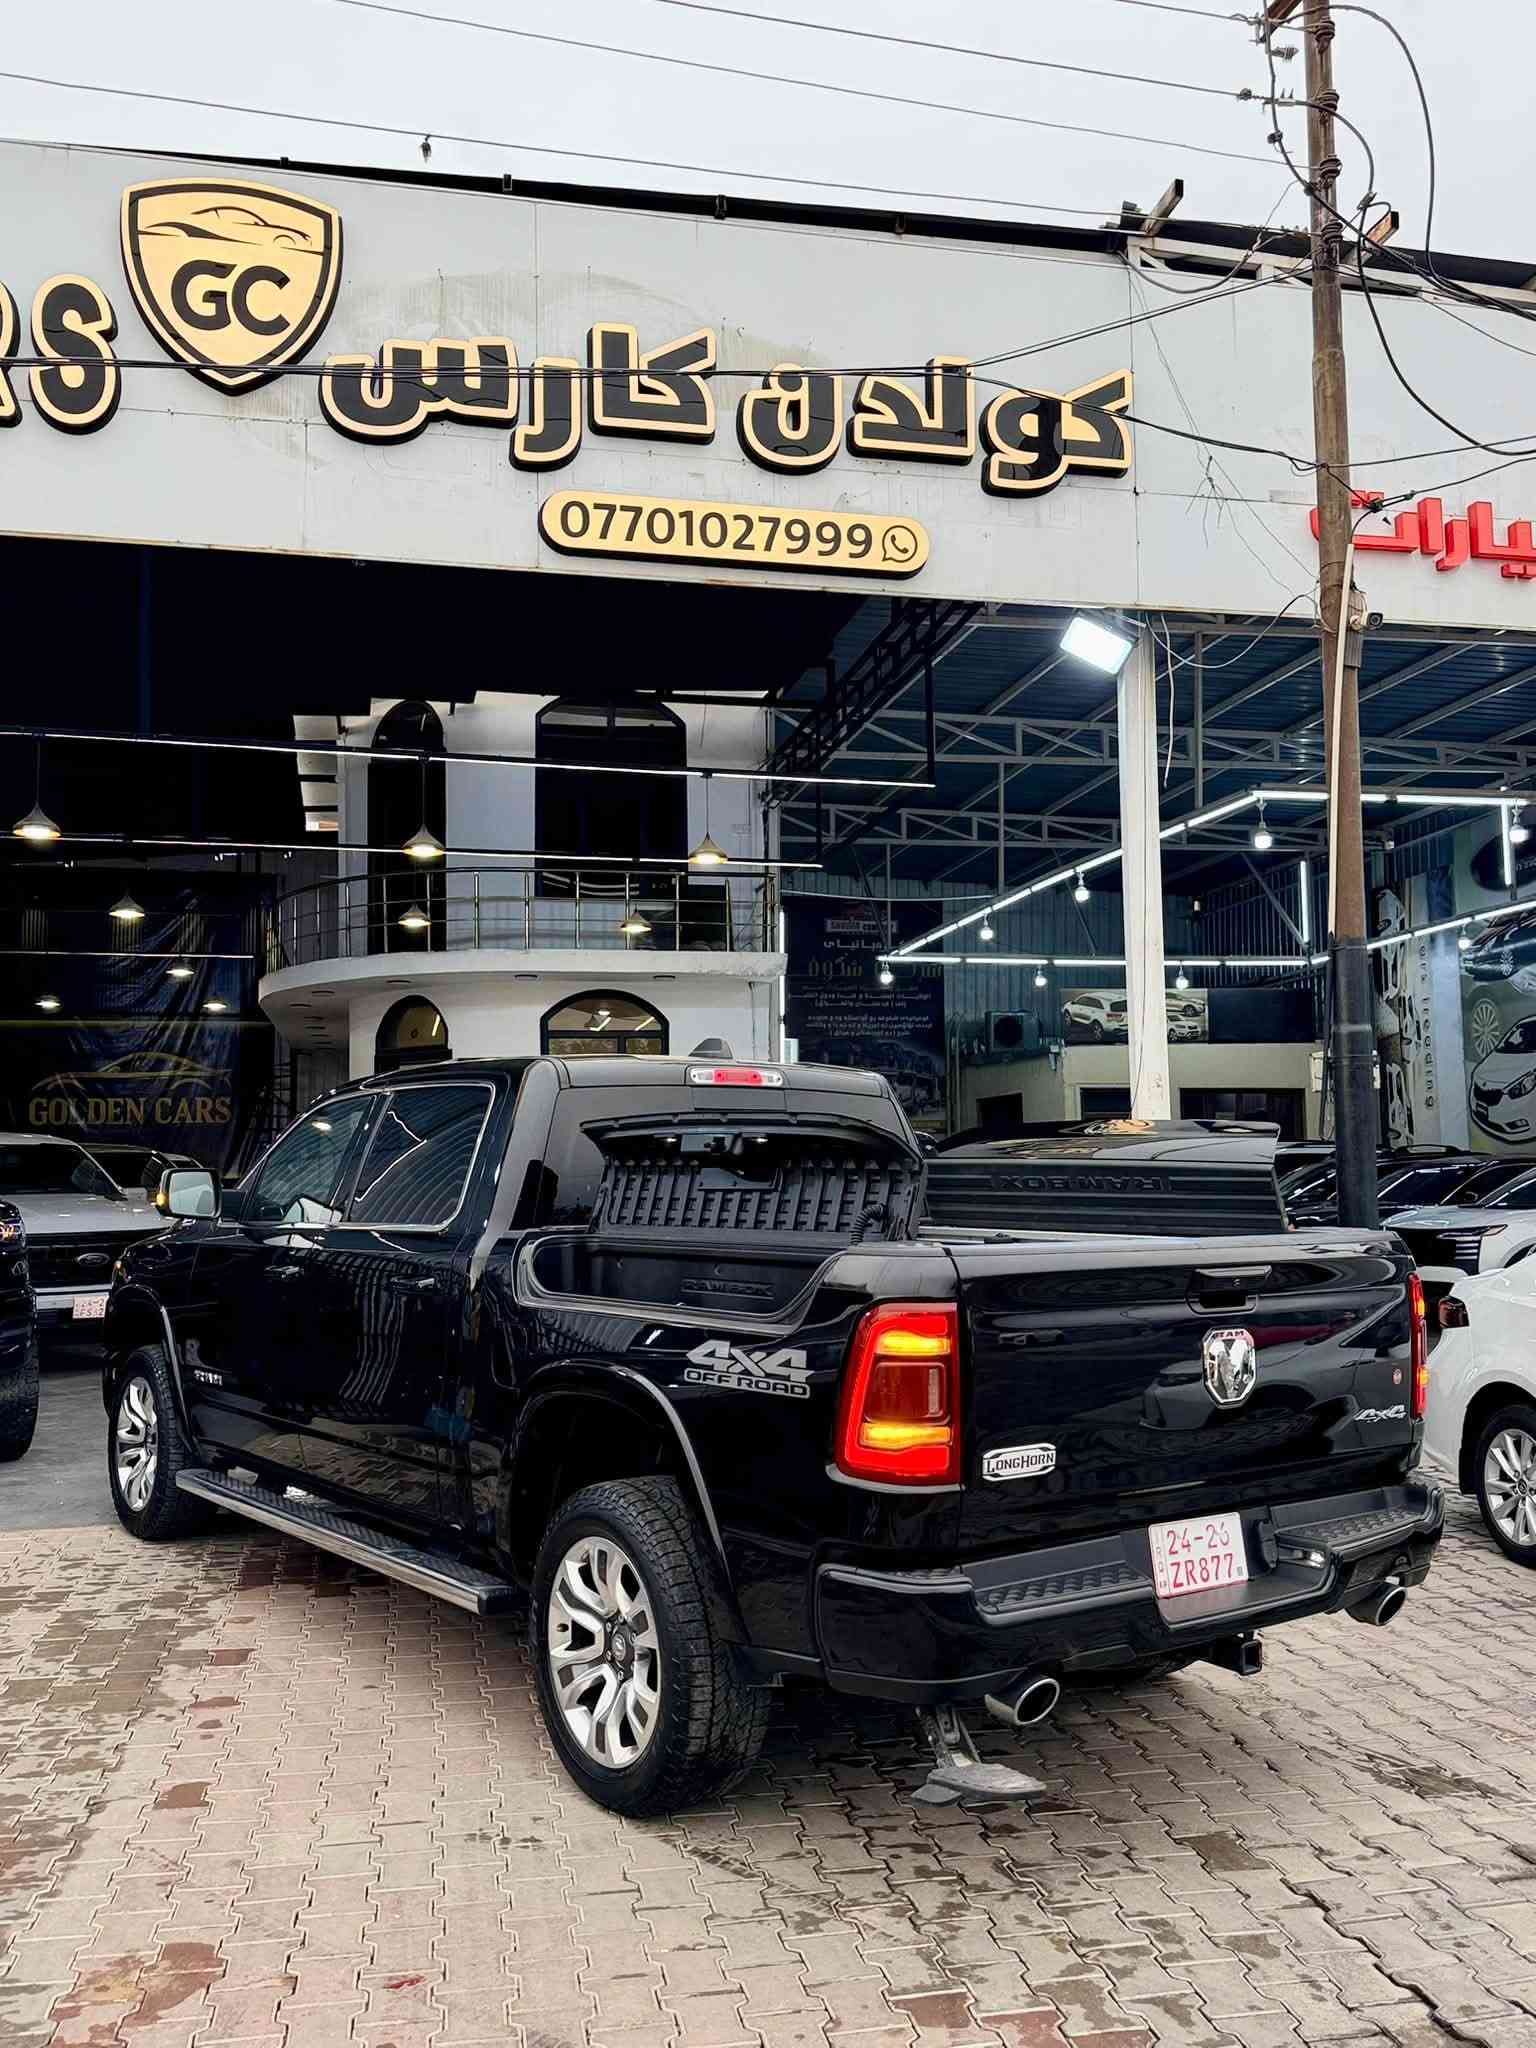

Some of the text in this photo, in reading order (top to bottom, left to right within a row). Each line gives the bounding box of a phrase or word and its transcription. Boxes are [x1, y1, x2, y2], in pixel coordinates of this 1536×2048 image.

[170, 258, 291, 337] GC
[0, 273, 122, 435] S
[560, 499, 873, 560] 07701027999
[28, 1095, 233, 1127] GOLDEN CARS
[1214, 1329, 1245, 1339] RAM
[686, 1369, 808, 1396] OFF ROAD
[1170, 1552, 1233, 1588] ZR877
